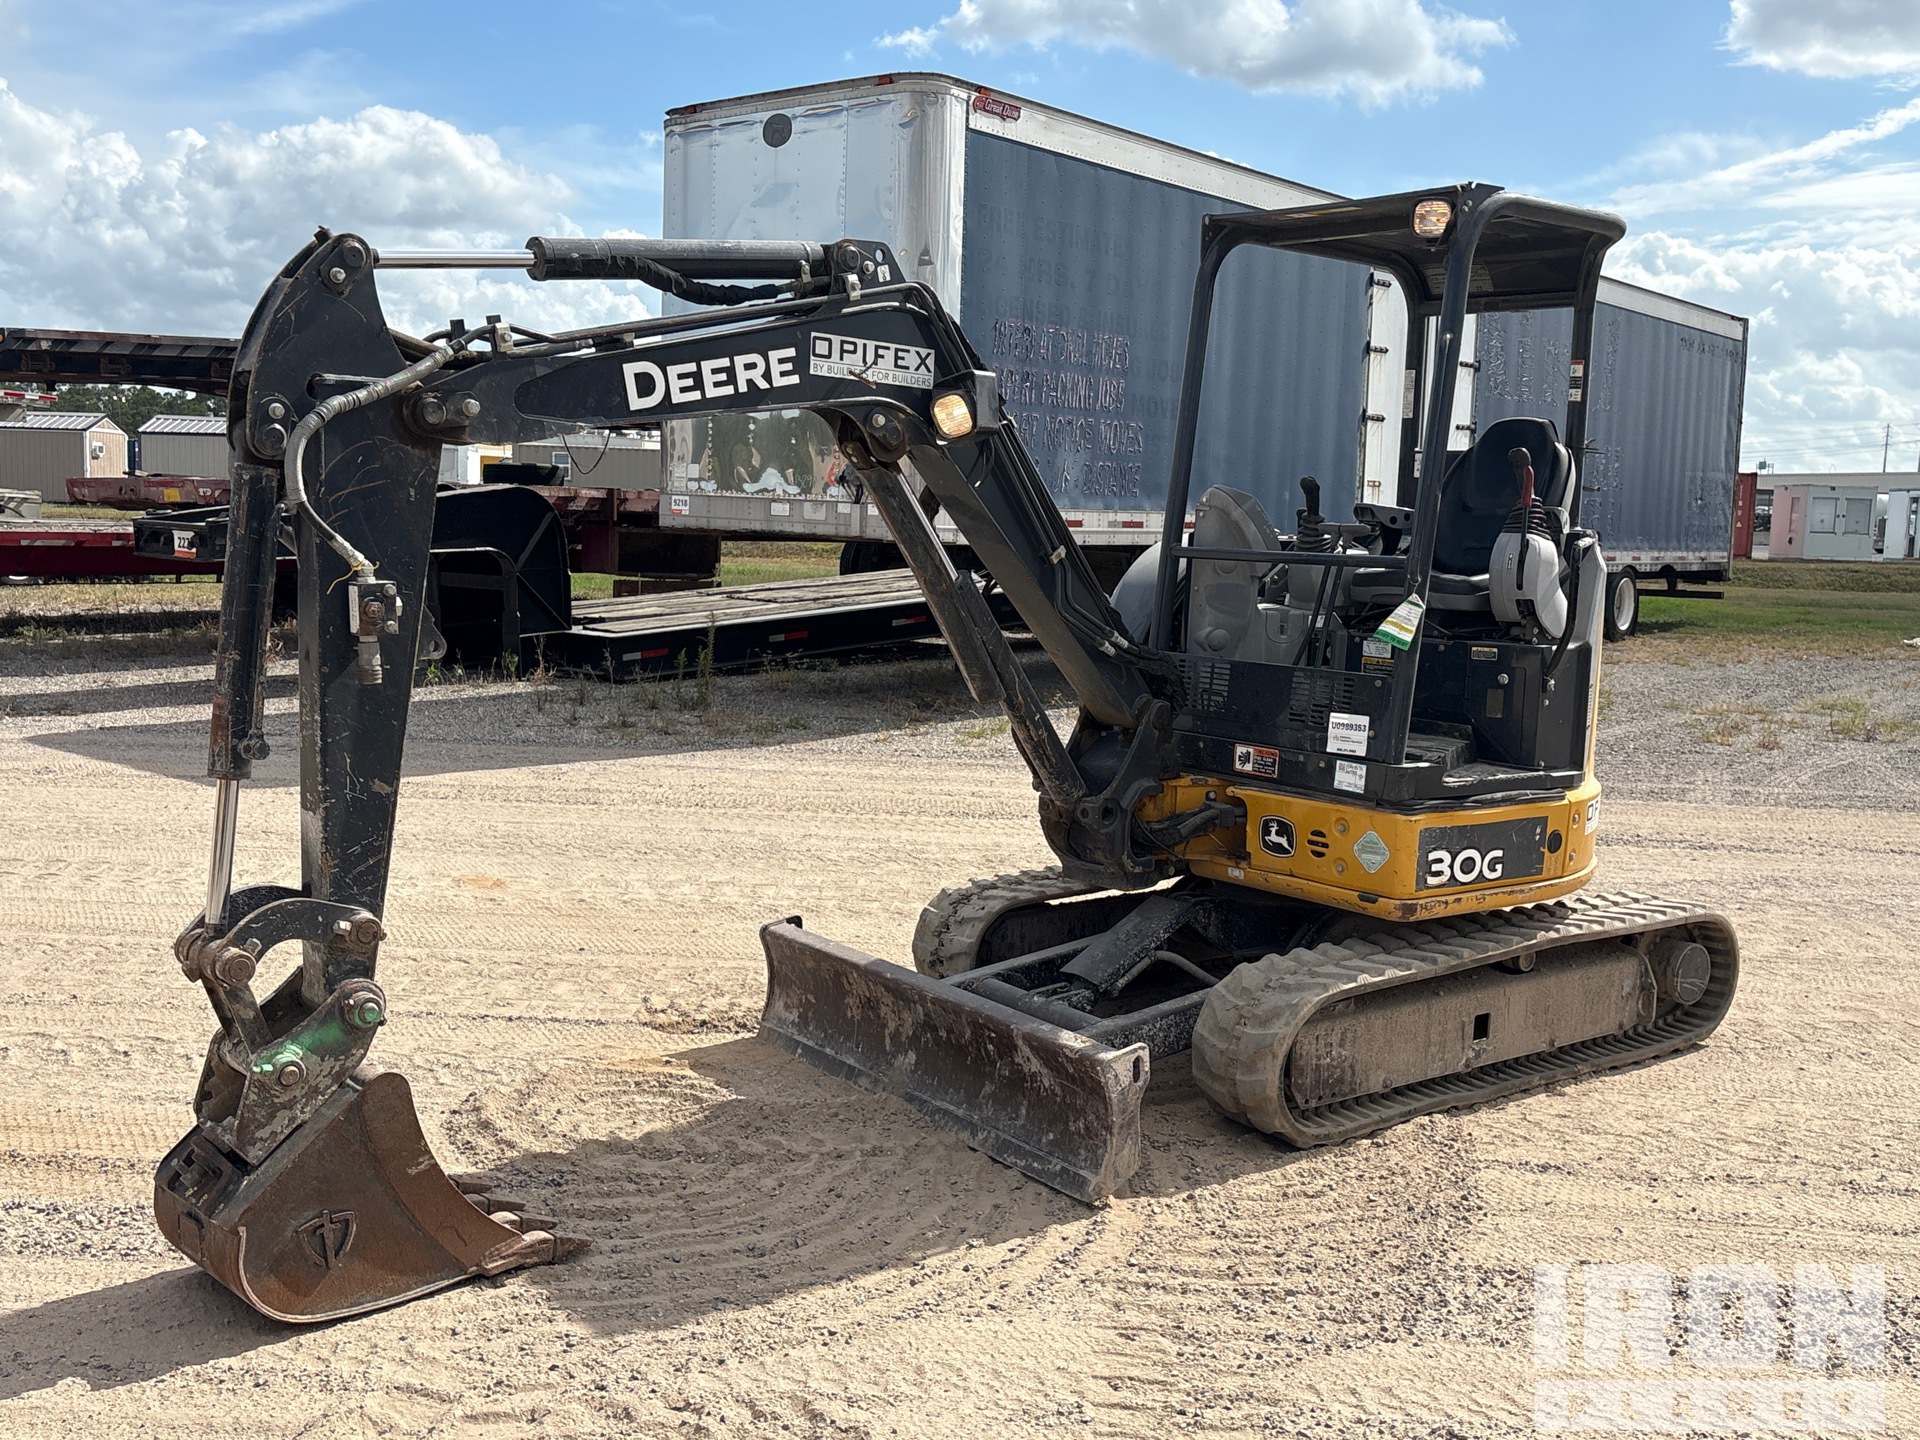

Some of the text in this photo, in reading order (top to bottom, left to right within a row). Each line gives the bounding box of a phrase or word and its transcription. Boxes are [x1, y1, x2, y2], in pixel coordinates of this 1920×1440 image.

[985, 98, 1018, 118] Great Dane
[812, 336, 932, 373] OPIFEX
[622, 347, 800, 411] DEERE
[813, 363, 825, 373] BY
[872, 370, 890, 382] FOR
[892, 375, 932, 388] BUILDERS
[1041, 369, 1094, 411] PACKING
[1095, 376, 1126, 413] JOBS
[1043, 413, 1095, 452] NOTICE
[1098, 417, 1144, 455] MOVES
[1082, 459, 1143, 498] DISTANCE
[1331, 720, 1367, 733] U0989353
[1426, 848, 1503, 885] 30G
